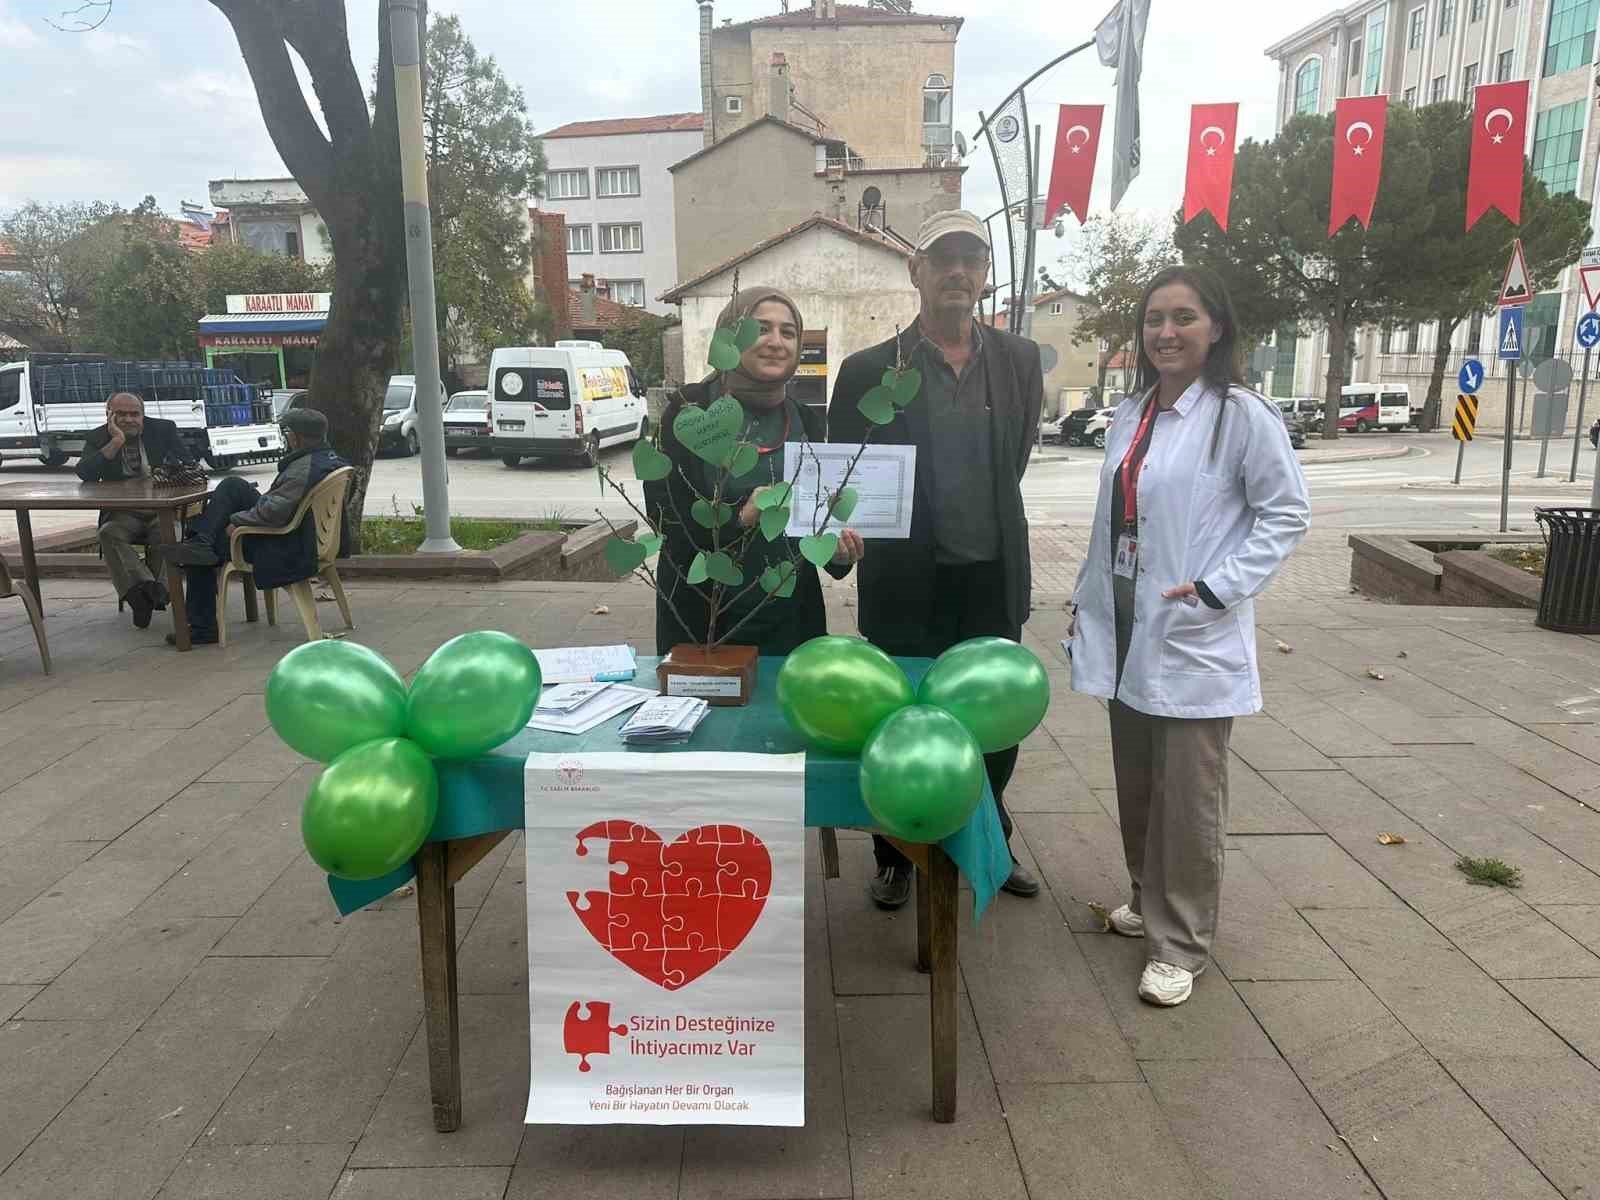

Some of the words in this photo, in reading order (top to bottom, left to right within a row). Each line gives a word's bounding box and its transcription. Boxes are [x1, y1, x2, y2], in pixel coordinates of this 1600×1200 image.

[245, 295, 283, 311] KARAATLI
[286, 294, 314, 311] MANAV
[215, 336, 273, 346] KARAATLI
[282, 335, 320, 346] MANA
[630, 1015, 670, 1032] Sizin
[676, 1015, 775, 1035] Desteğinize
[630, 1036, 722, 1058] İhtiyacımız
[728, 1039, 756, 1056] Var
[606, 1084, 662, 1098] Bağışlanan
[665, 1084, 683, 1095] Her
[686, 1084, 700, 1095] Bir
[703, 1084, 734, 1098] Organ
[589, 1100, 610, 1111] Yeni
[612, 1100, 627, 1111] Bir
[630, 1100, 670, 1113] Hayatın
[672, 1100, 712, 1111] Devamı
[714, 1100, 750, 1112] Olacak
